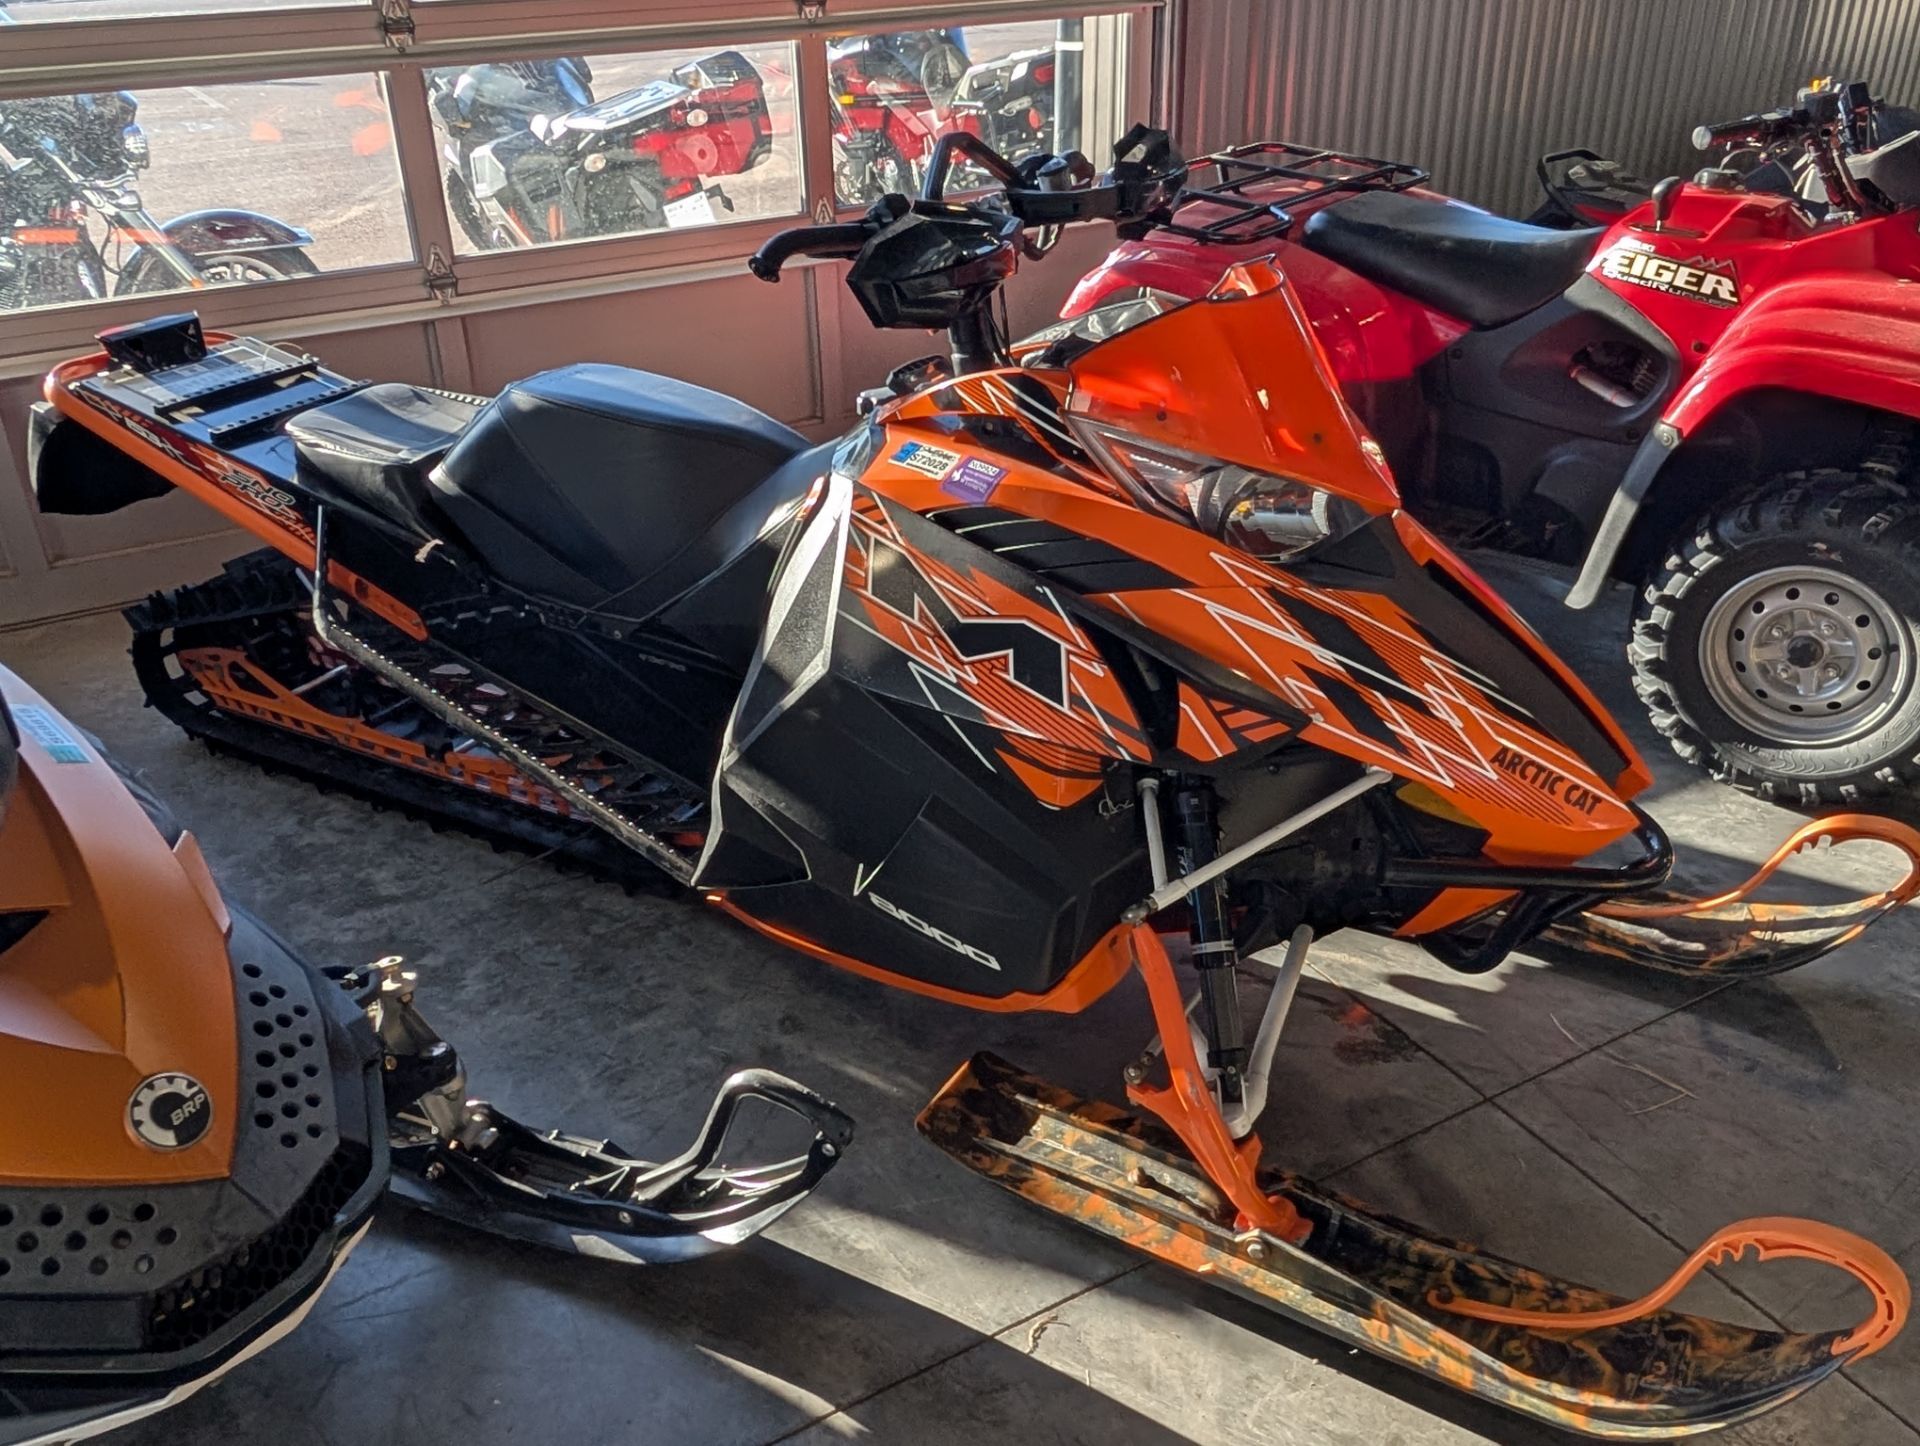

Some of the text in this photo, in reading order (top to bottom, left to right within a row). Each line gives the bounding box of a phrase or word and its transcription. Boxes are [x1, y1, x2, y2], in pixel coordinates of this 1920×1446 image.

[1602, 250, 1739, 303] EIGER
[220, 475, 282, 508] PRO
[231, 469, 296, 505] SNO
[1489, 745, 1603, 816] ARCTIC CAT
[867, 891, 1002, 971] 8000
[170, 1093, 206, 1126] BRP
